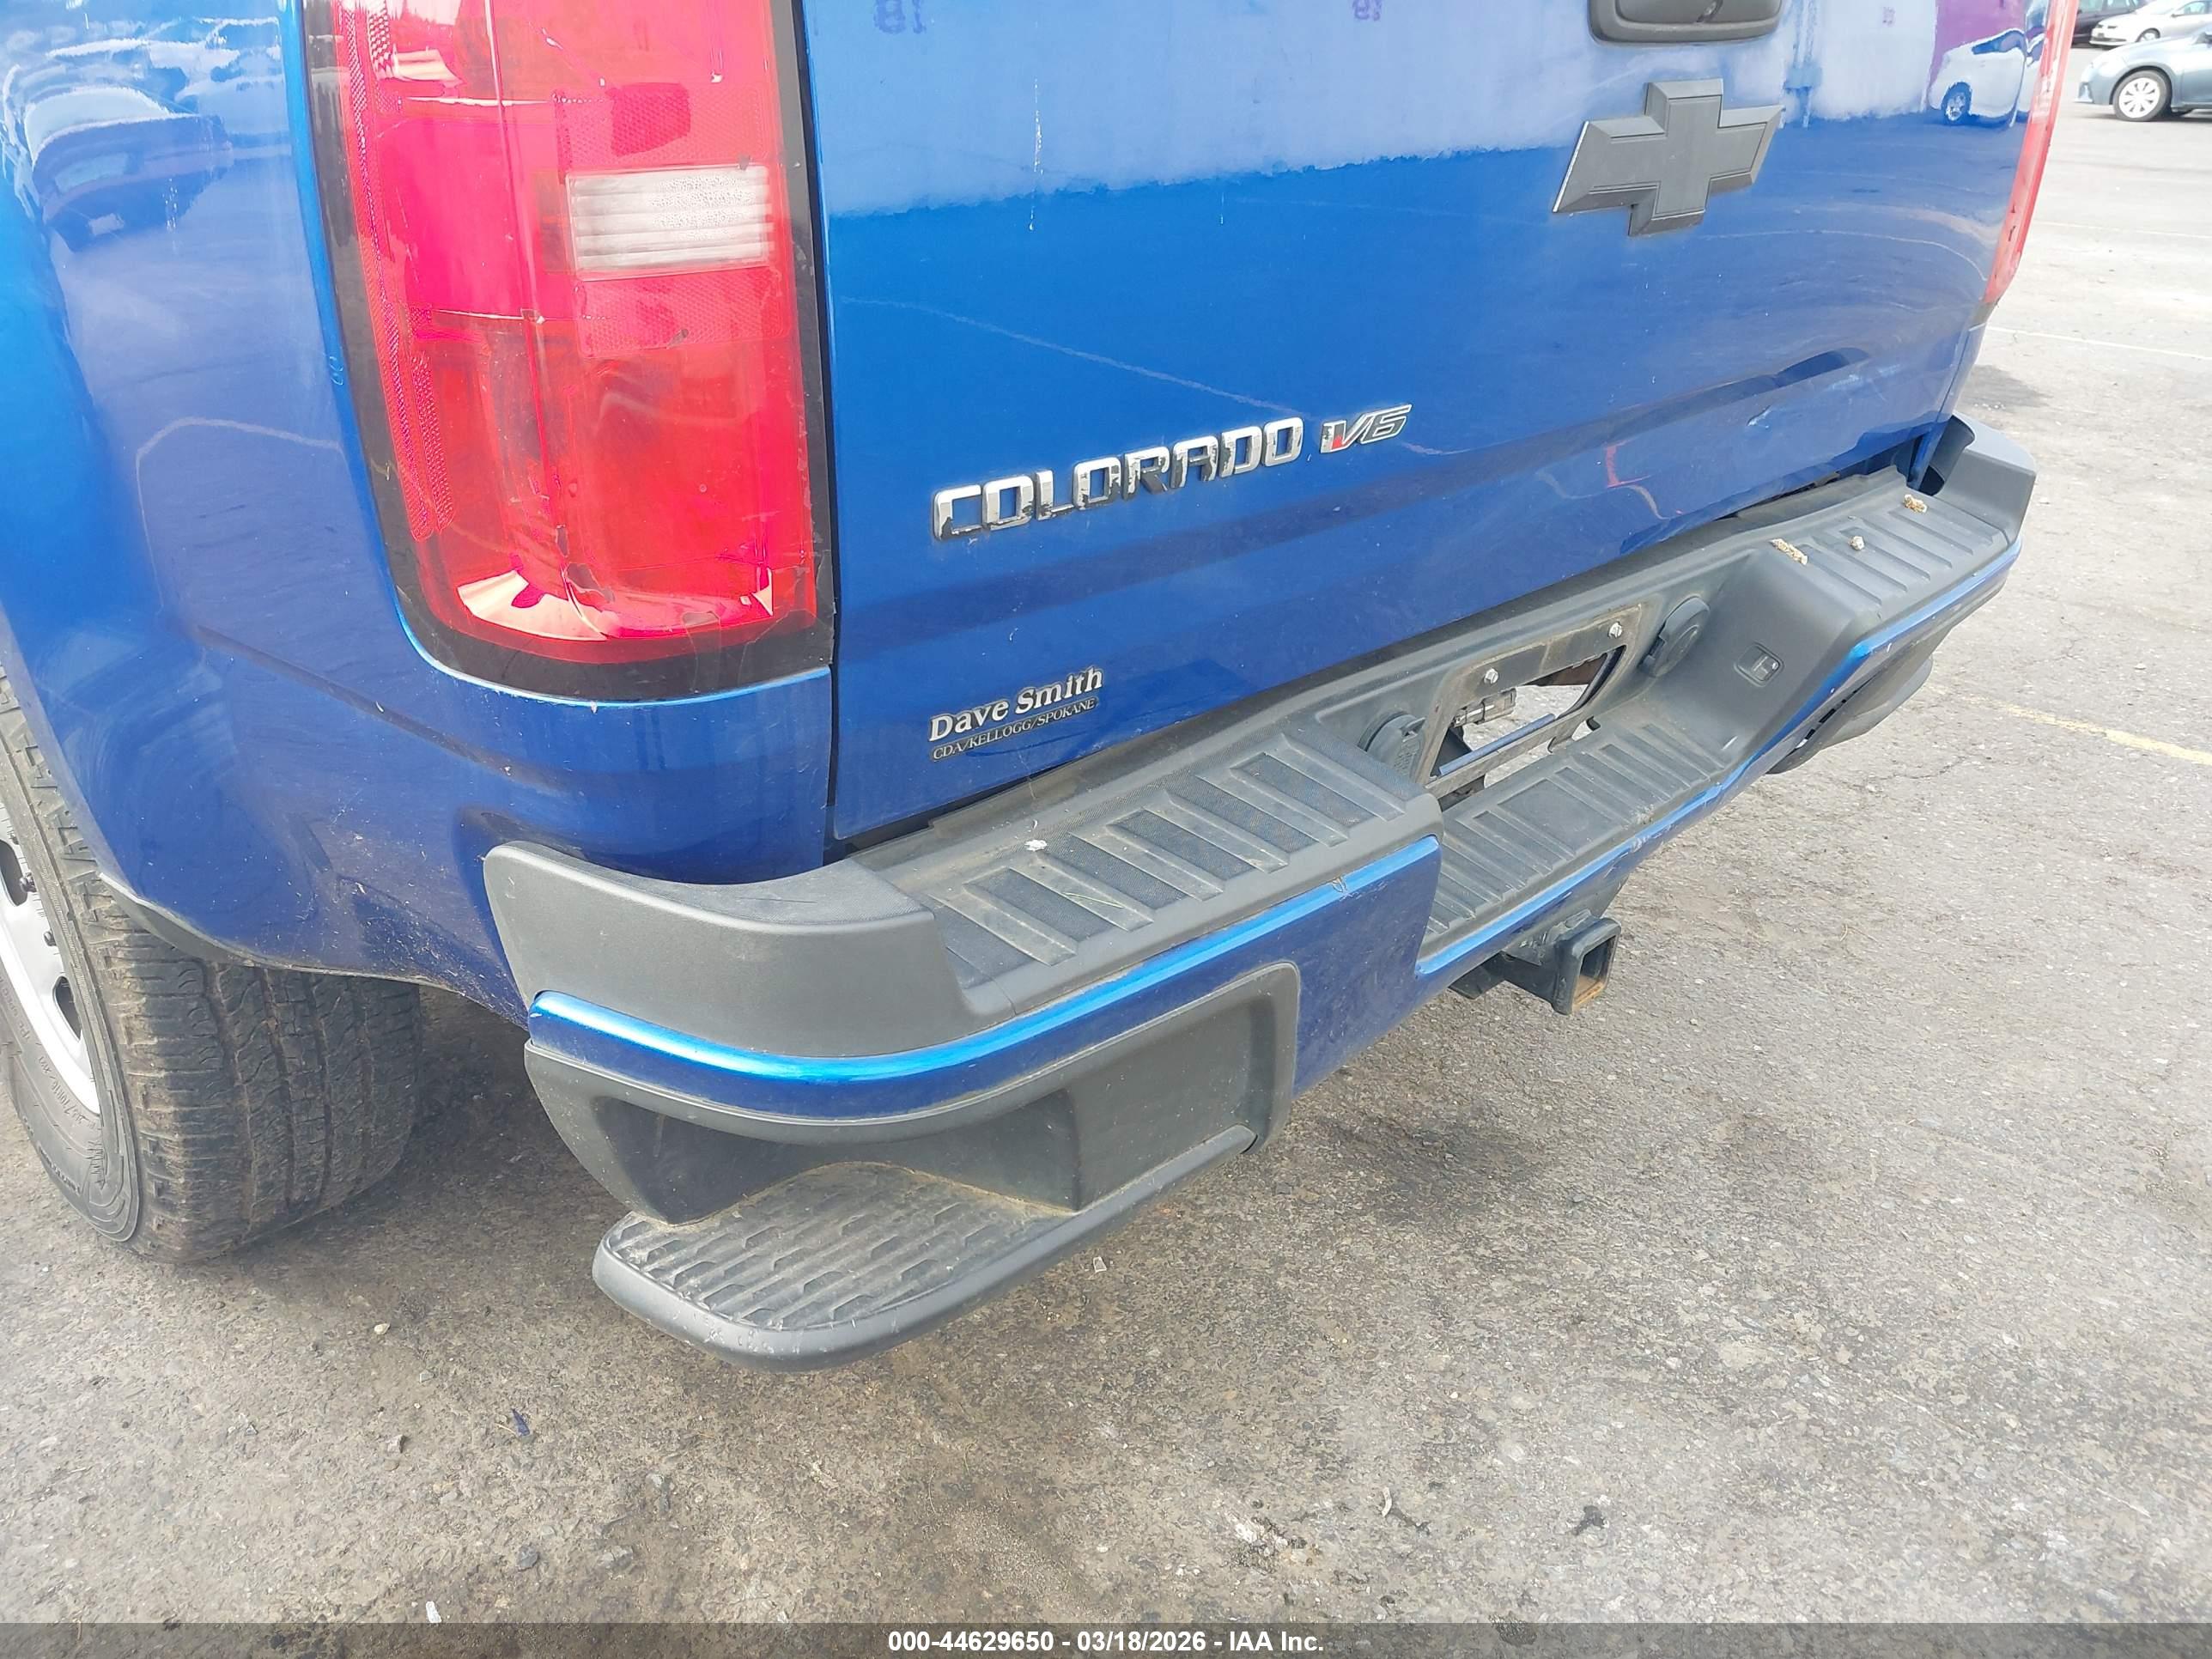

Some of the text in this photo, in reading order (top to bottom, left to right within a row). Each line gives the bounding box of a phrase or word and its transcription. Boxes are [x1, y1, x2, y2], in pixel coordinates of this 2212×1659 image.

[933, 404, 1413, 541] COLORADO V6
[928, 665, 1103, 742] Dave Smith
[933, 697, 1097, 760] CDA/KELLOGG/SPOKANE
